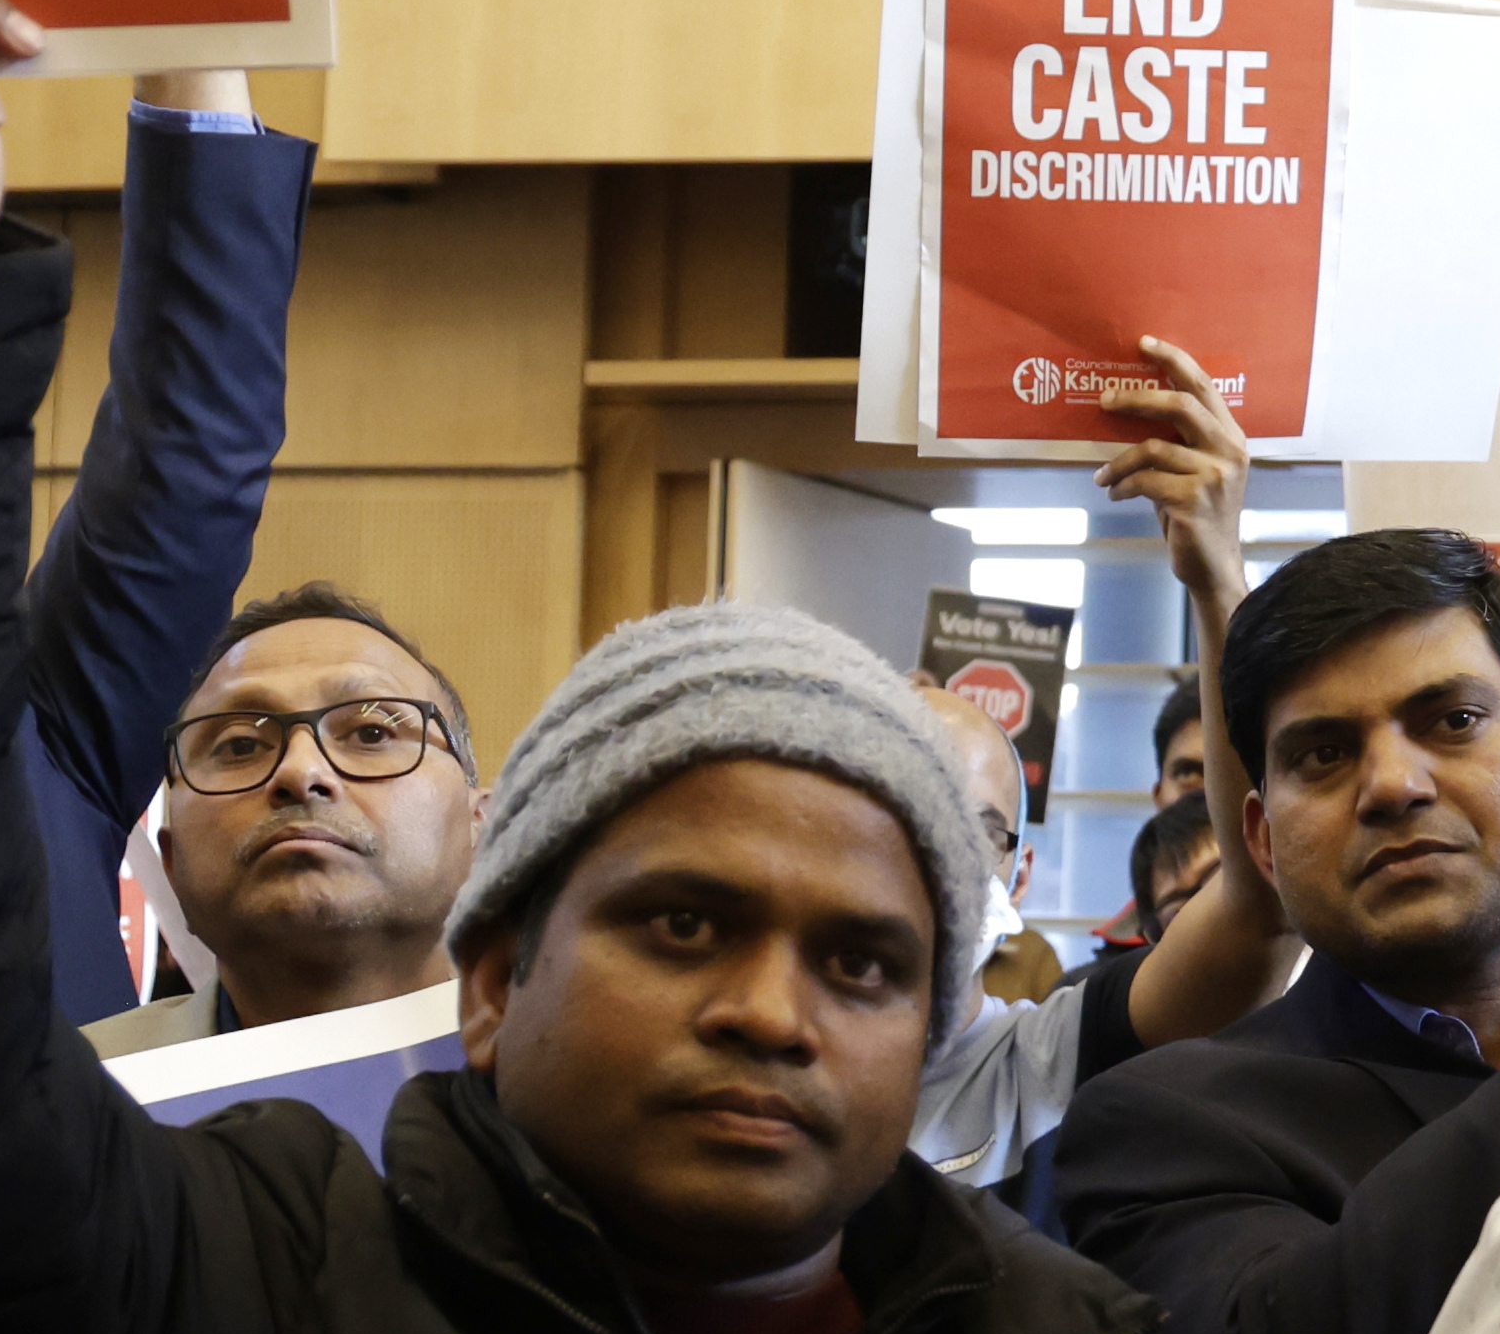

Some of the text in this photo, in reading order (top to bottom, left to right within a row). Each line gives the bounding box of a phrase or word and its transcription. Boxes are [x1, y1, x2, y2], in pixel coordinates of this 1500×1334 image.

[1011, 43, 1269, 145] CASTE
[971, 150, 1300, 205] DISCRIMINATION
[1065, 370, 1159, 391] Kshama
